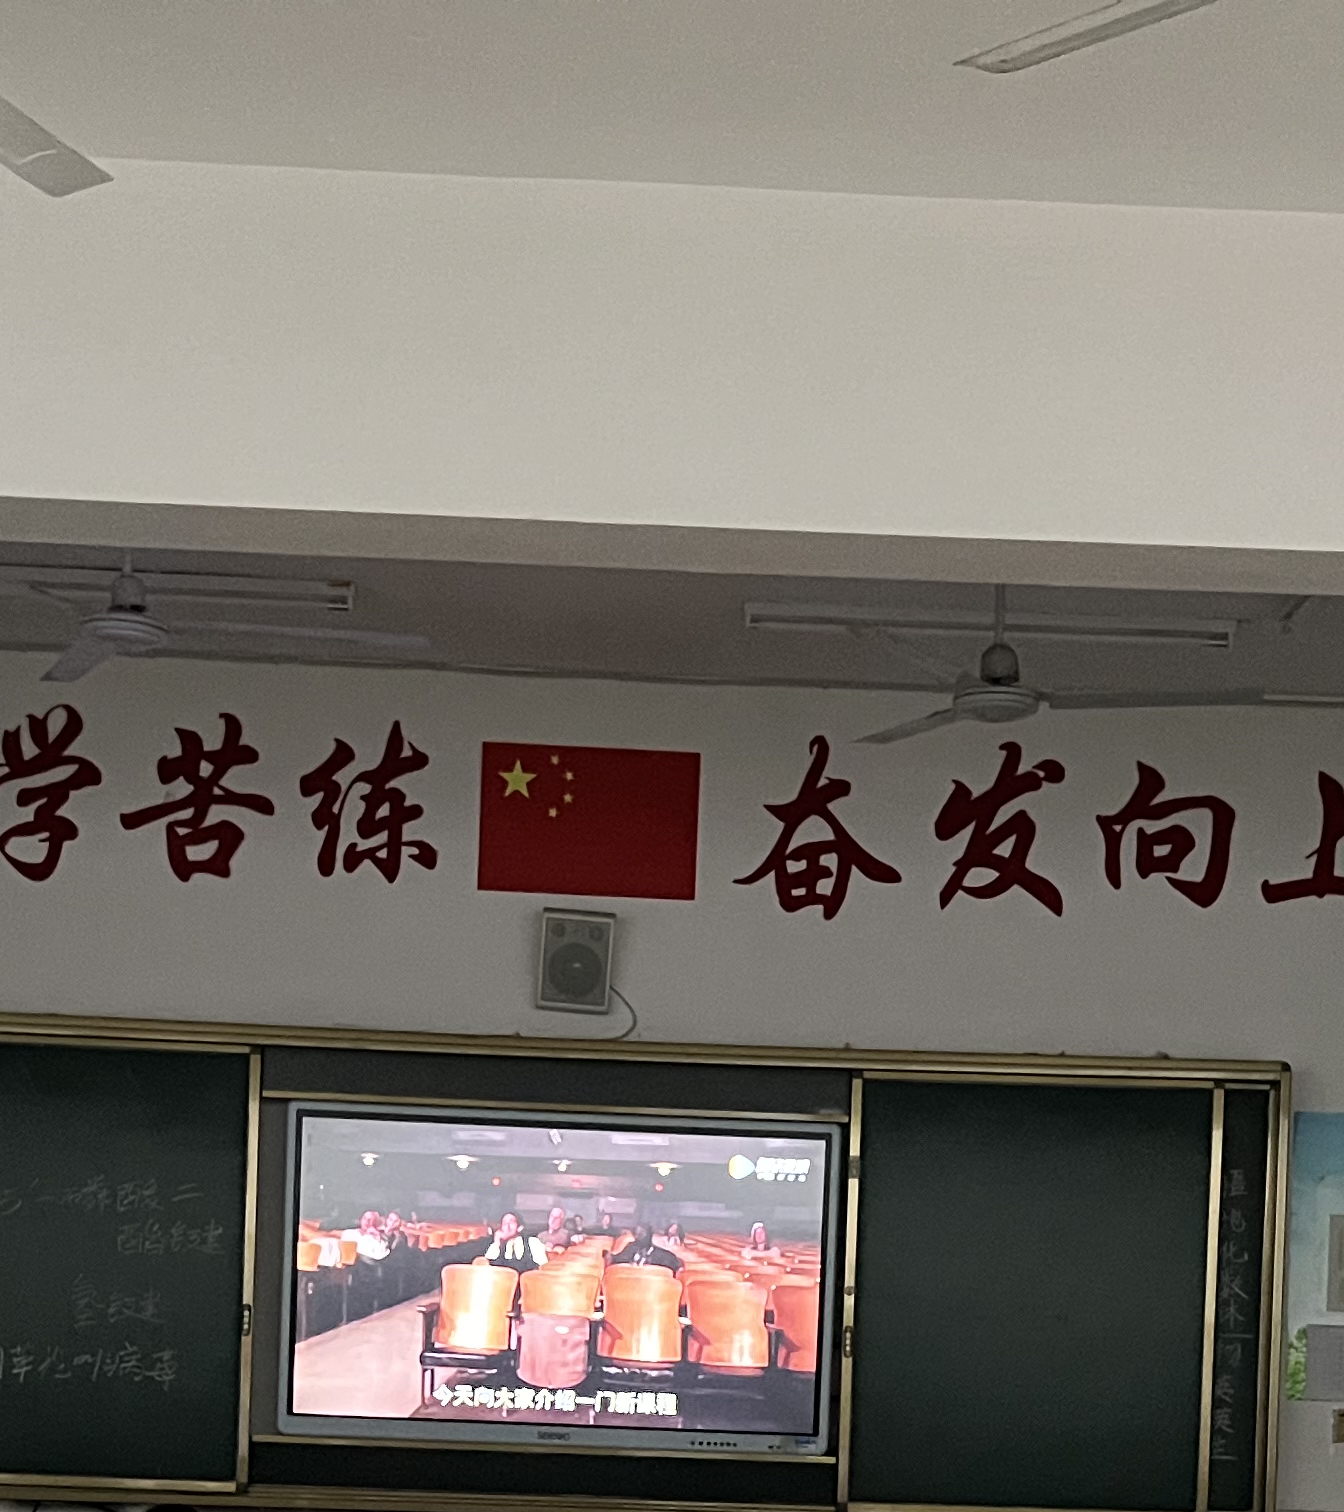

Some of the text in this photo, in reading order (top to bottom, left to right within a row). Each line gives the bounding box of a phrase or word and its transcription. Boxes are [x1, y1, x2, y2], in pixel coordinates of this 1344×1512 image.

[432, 1384, 678, 1416] 今天向大家介绍一门新课程
